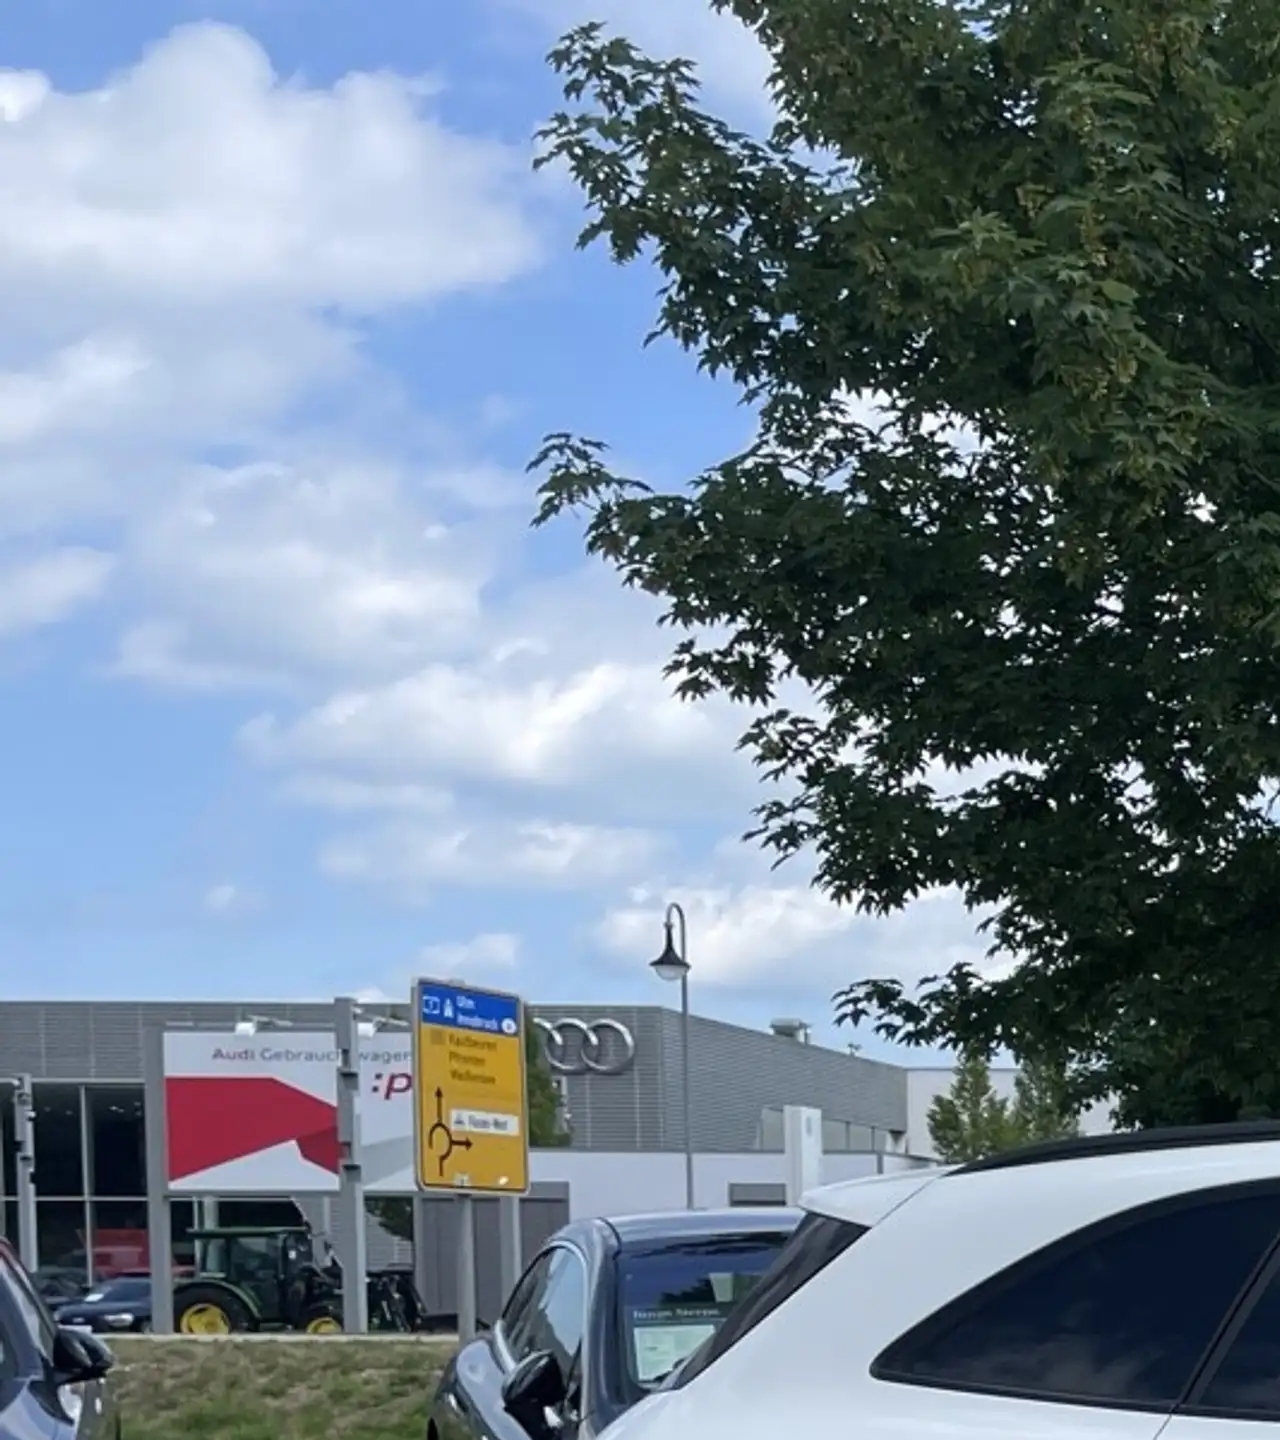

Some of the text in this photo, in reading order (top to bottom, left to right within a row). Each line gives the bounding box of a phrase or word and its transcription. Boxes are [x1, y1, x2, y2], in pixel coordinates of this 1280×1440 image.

[212, 1048, 411, 1065] Audi Gebraucwagen
[372, 1072, 412, 1100] :p
